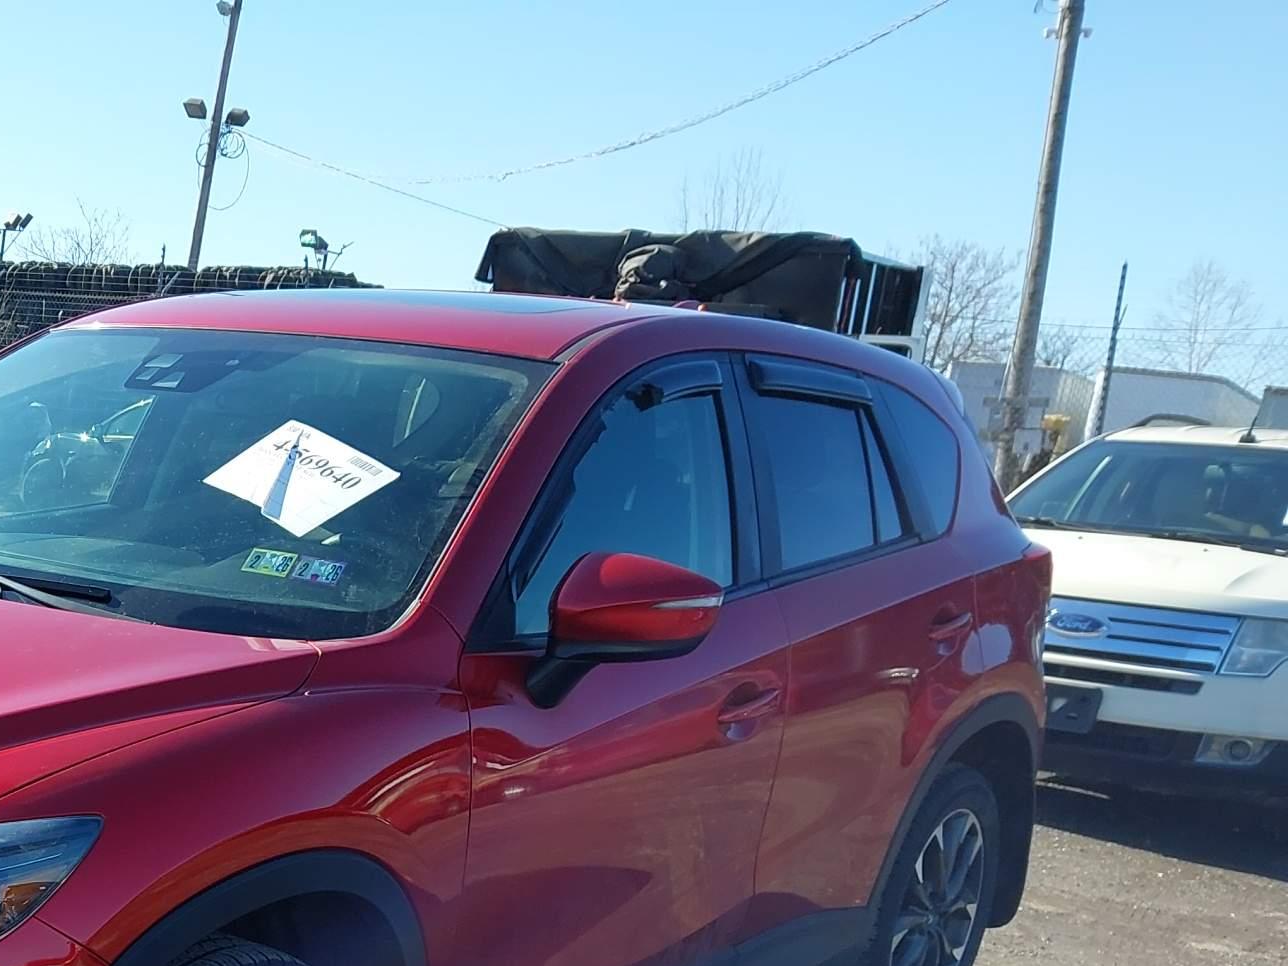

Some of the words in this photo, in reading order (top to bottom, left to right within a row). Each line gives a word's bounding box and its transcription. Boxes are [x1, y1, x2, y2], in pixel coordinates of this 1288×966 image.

[249, 554, 261, 569] 2
[275, 556, 293, 573] 26
[298, 562, 310, 577] 2
[325, 564, 343, 582] 26
[1056, 616, 1093, 631] Ford
